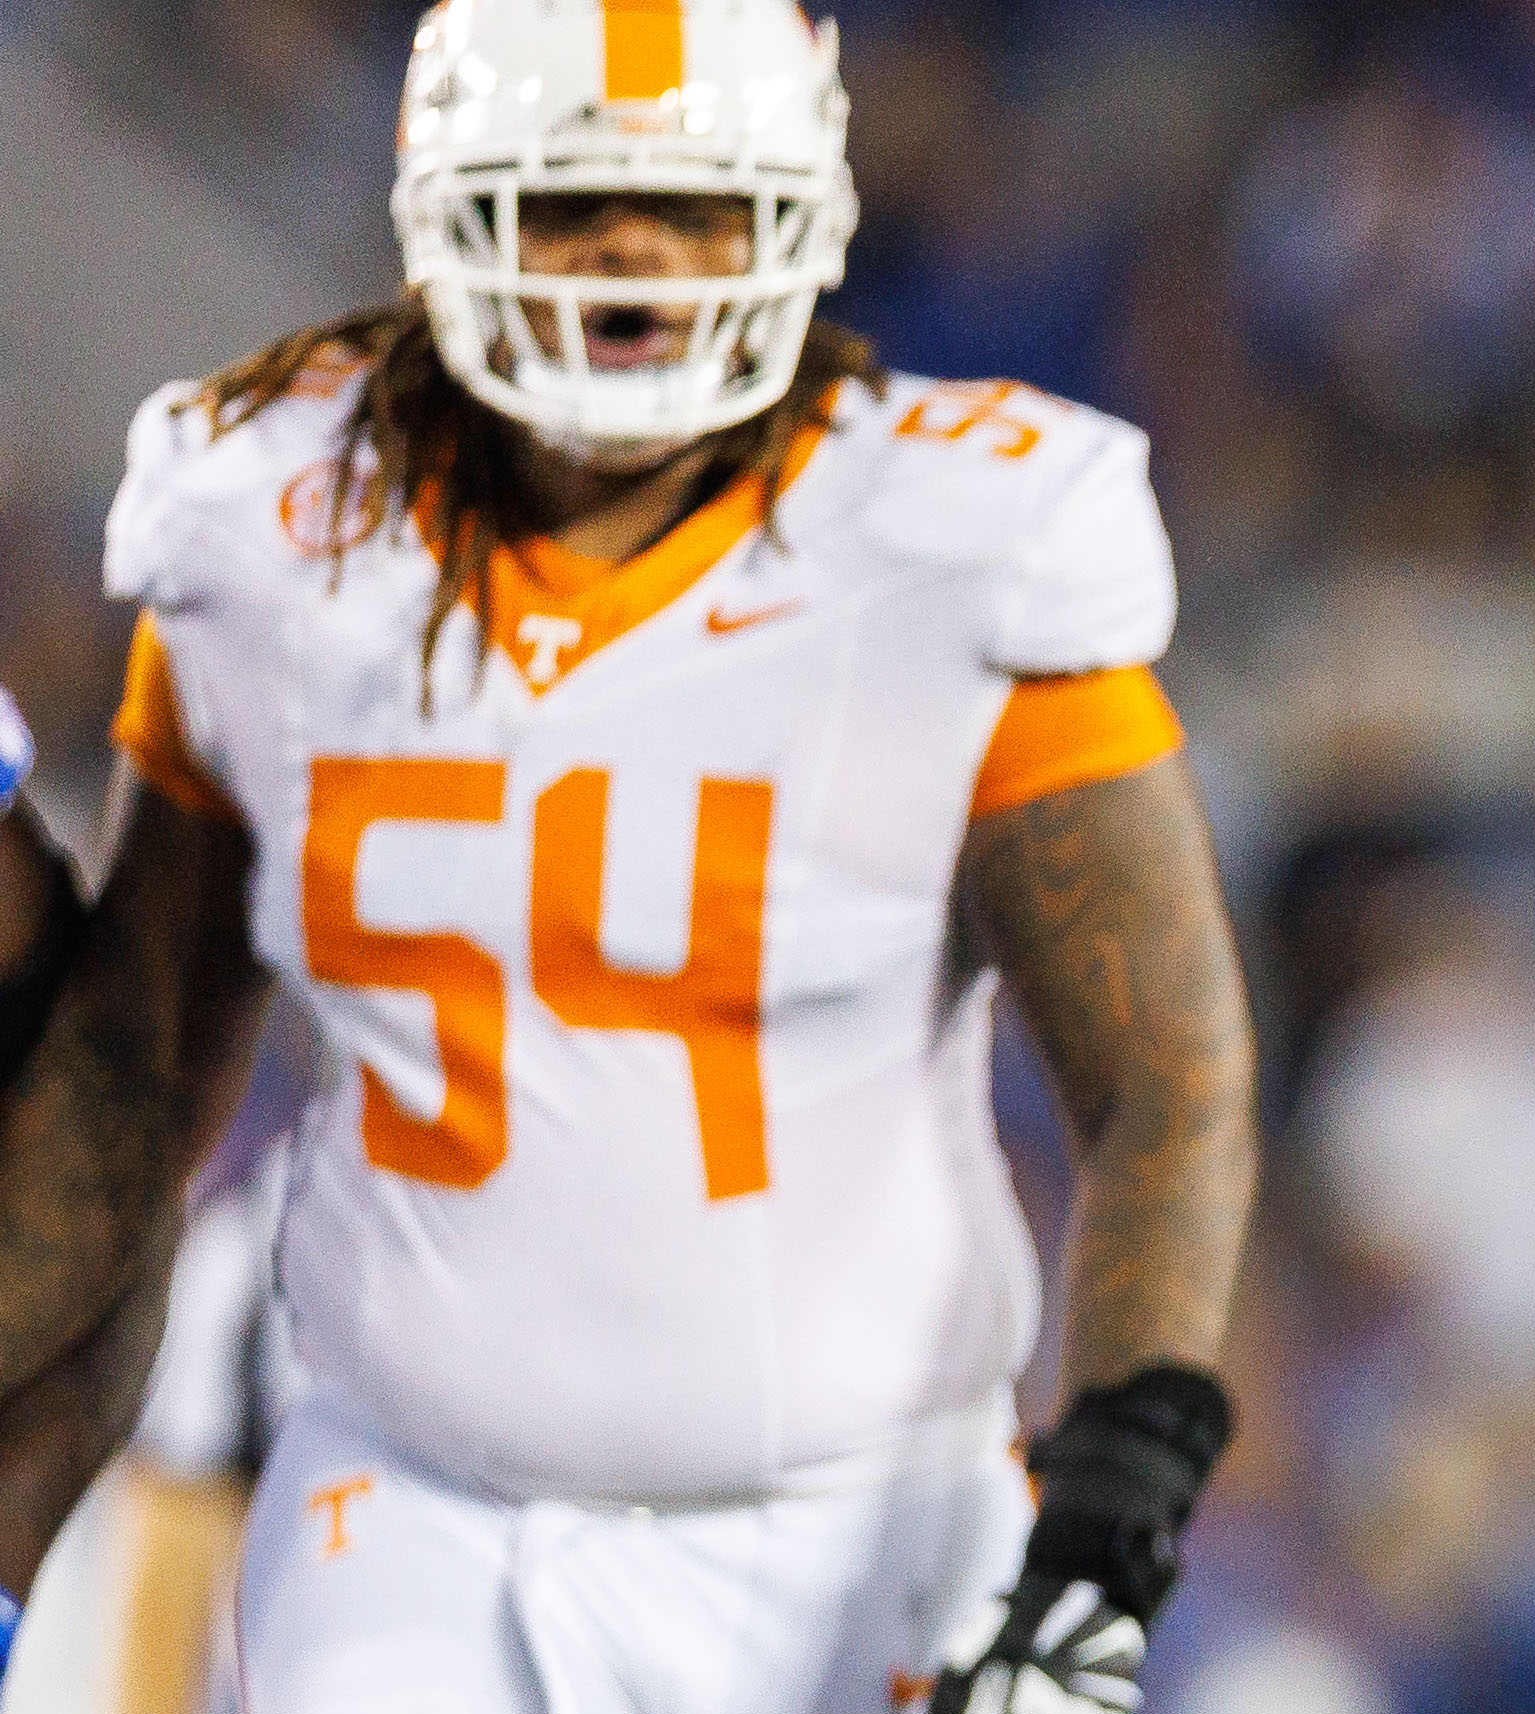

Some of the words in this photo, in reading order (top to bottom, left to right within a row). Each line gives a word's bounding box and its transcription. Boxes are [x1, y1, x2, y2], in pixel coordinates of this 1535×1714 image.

[516, 612, 583, 685] T
[301, 755, 774, 1201] 54
[308, 1472, 376, 1557] T
